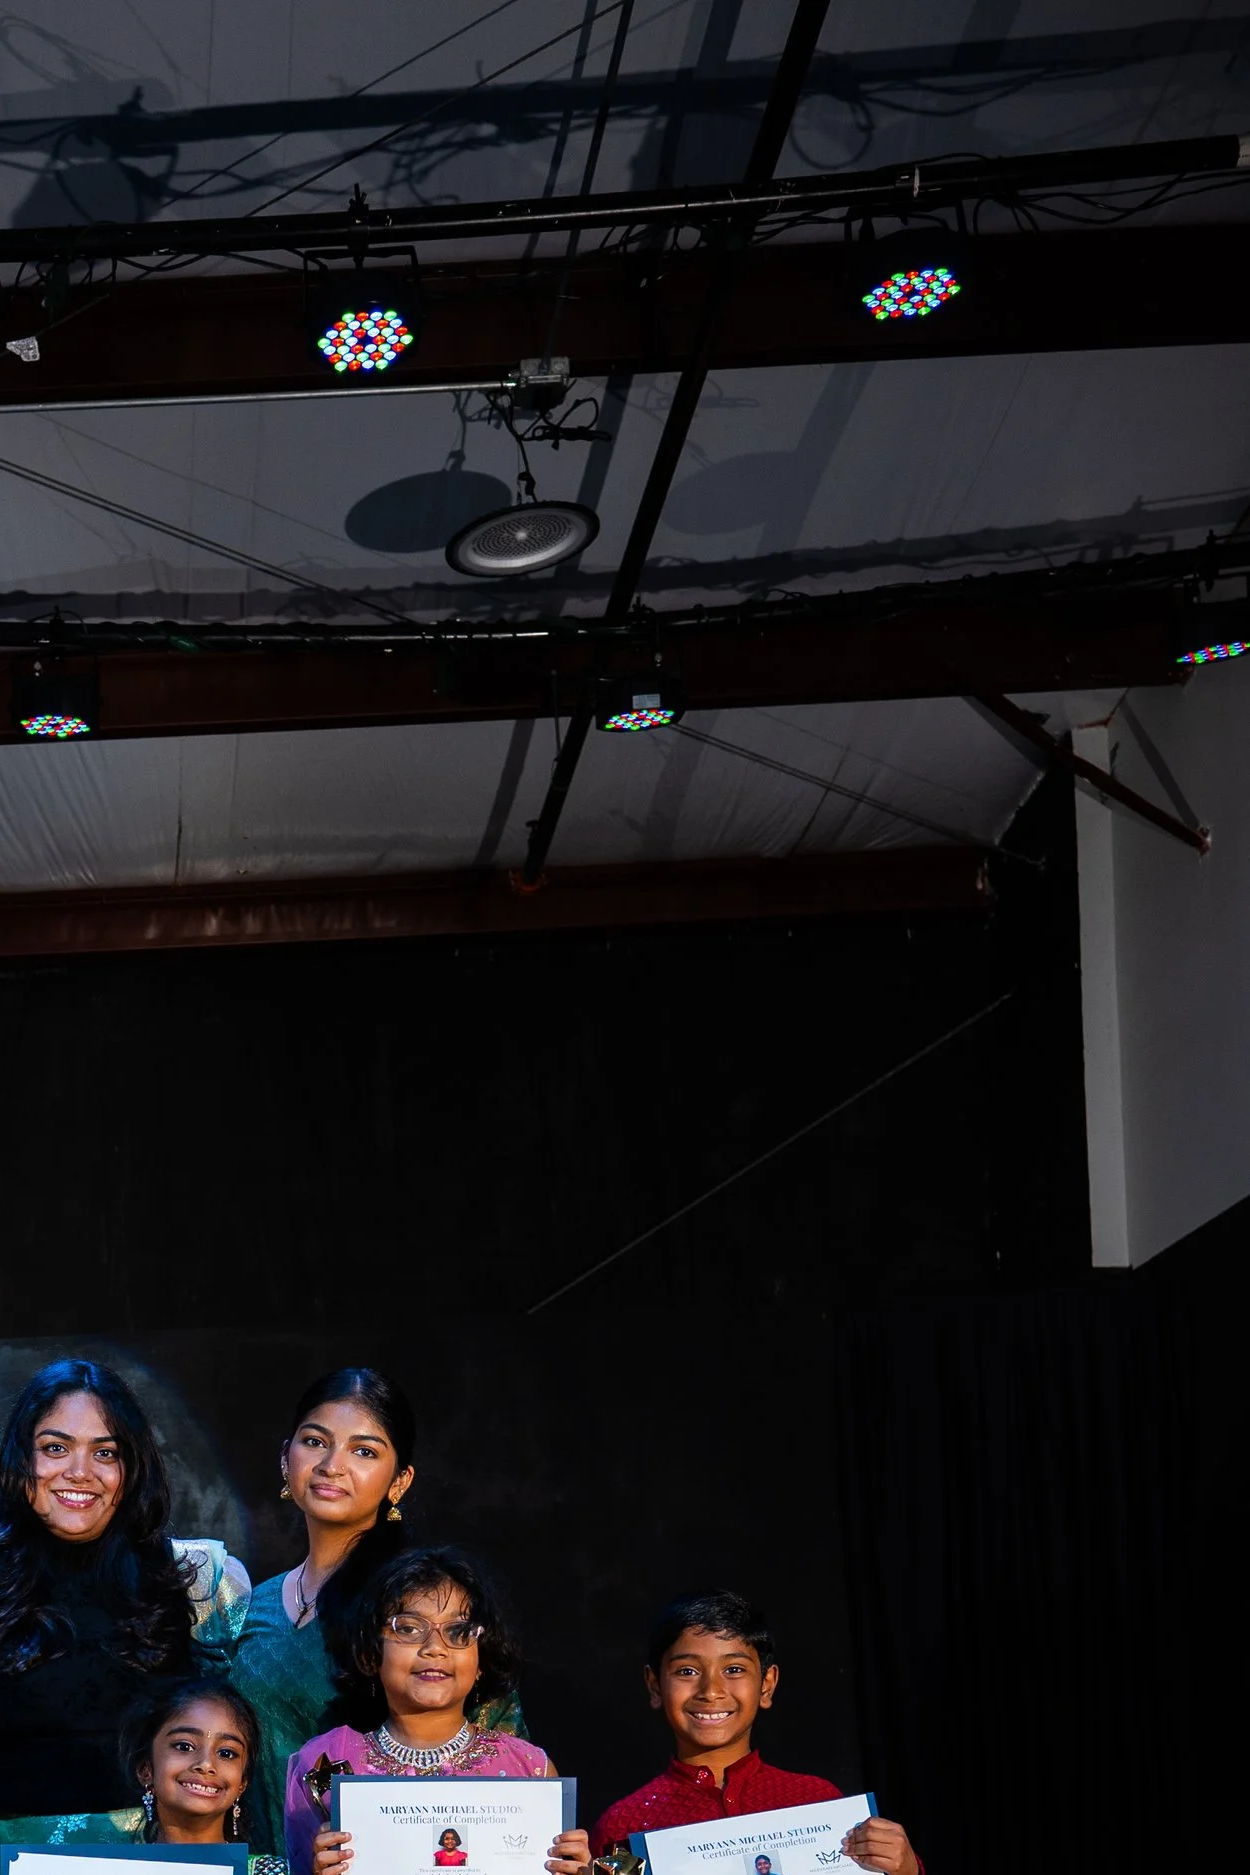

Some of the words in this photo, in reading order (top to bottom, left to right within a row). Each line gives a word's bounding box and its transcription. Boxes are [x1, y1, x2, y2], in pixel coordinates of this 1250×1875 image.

[380, 1806, 428, 1814] MARYANN
[432, 1806, 478, 1814] MICHAEL
[393, 1815, 440, 1824] Certificate
[443, 1815, 452, 1824] of
[454, 1815, 506, 1825] Completion
[687, 1839, 736, 1854] MARYANN
[739, 1831, 786, 1845] MICHAEL
[788, 1824, 832, 1837] STUDIOS
[702, 1846, 750, 1859] Certificate
[752, 1843, 761, 1852] of
[763, 1836, 816, 1851] Completion
